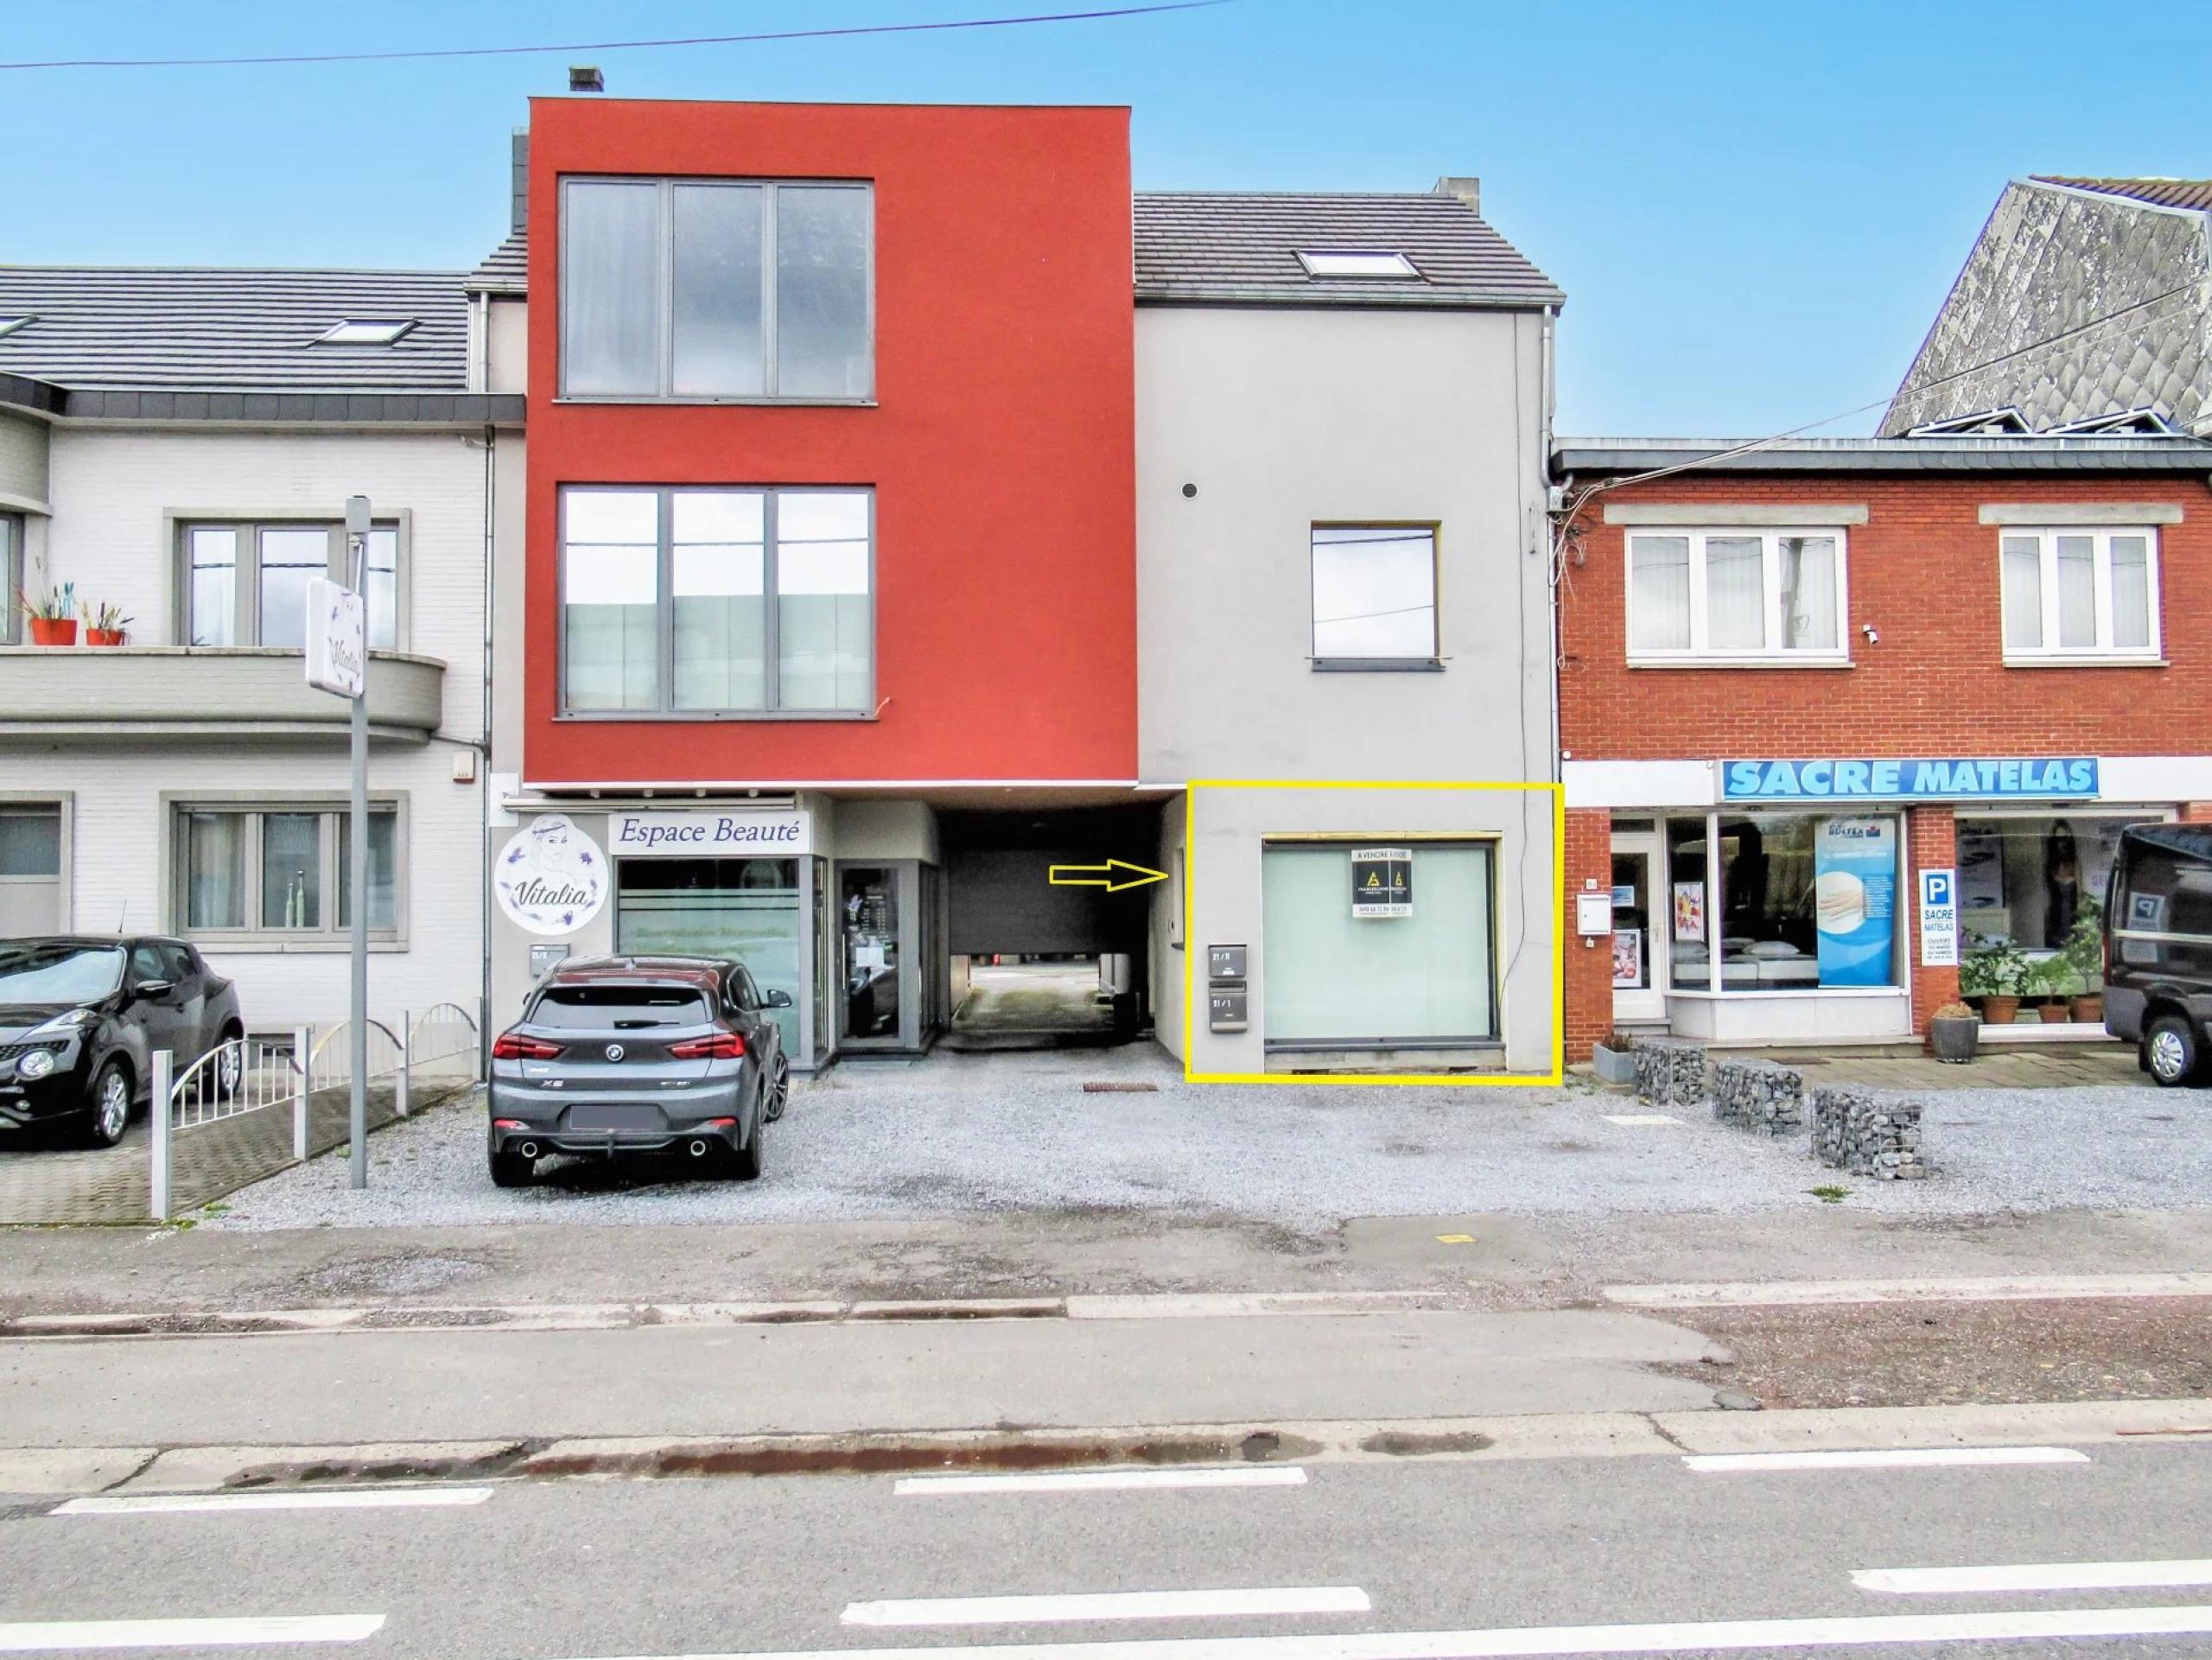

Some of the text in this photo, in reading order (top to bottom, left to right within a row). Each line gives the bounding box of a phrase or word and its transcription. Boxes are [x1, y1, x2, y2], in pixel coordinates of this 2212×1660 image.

[1730, 760, 2093, 795] SACRE MATELAS
[619, 817, 800, 848] Espace Beauté
[515, 876, 589, 906] Vitalia
[1928, 878, 1946, 901] P
[1924, 909, 1953, 920] SACRE
[1924, 922, 1953, 932] MATELAS
